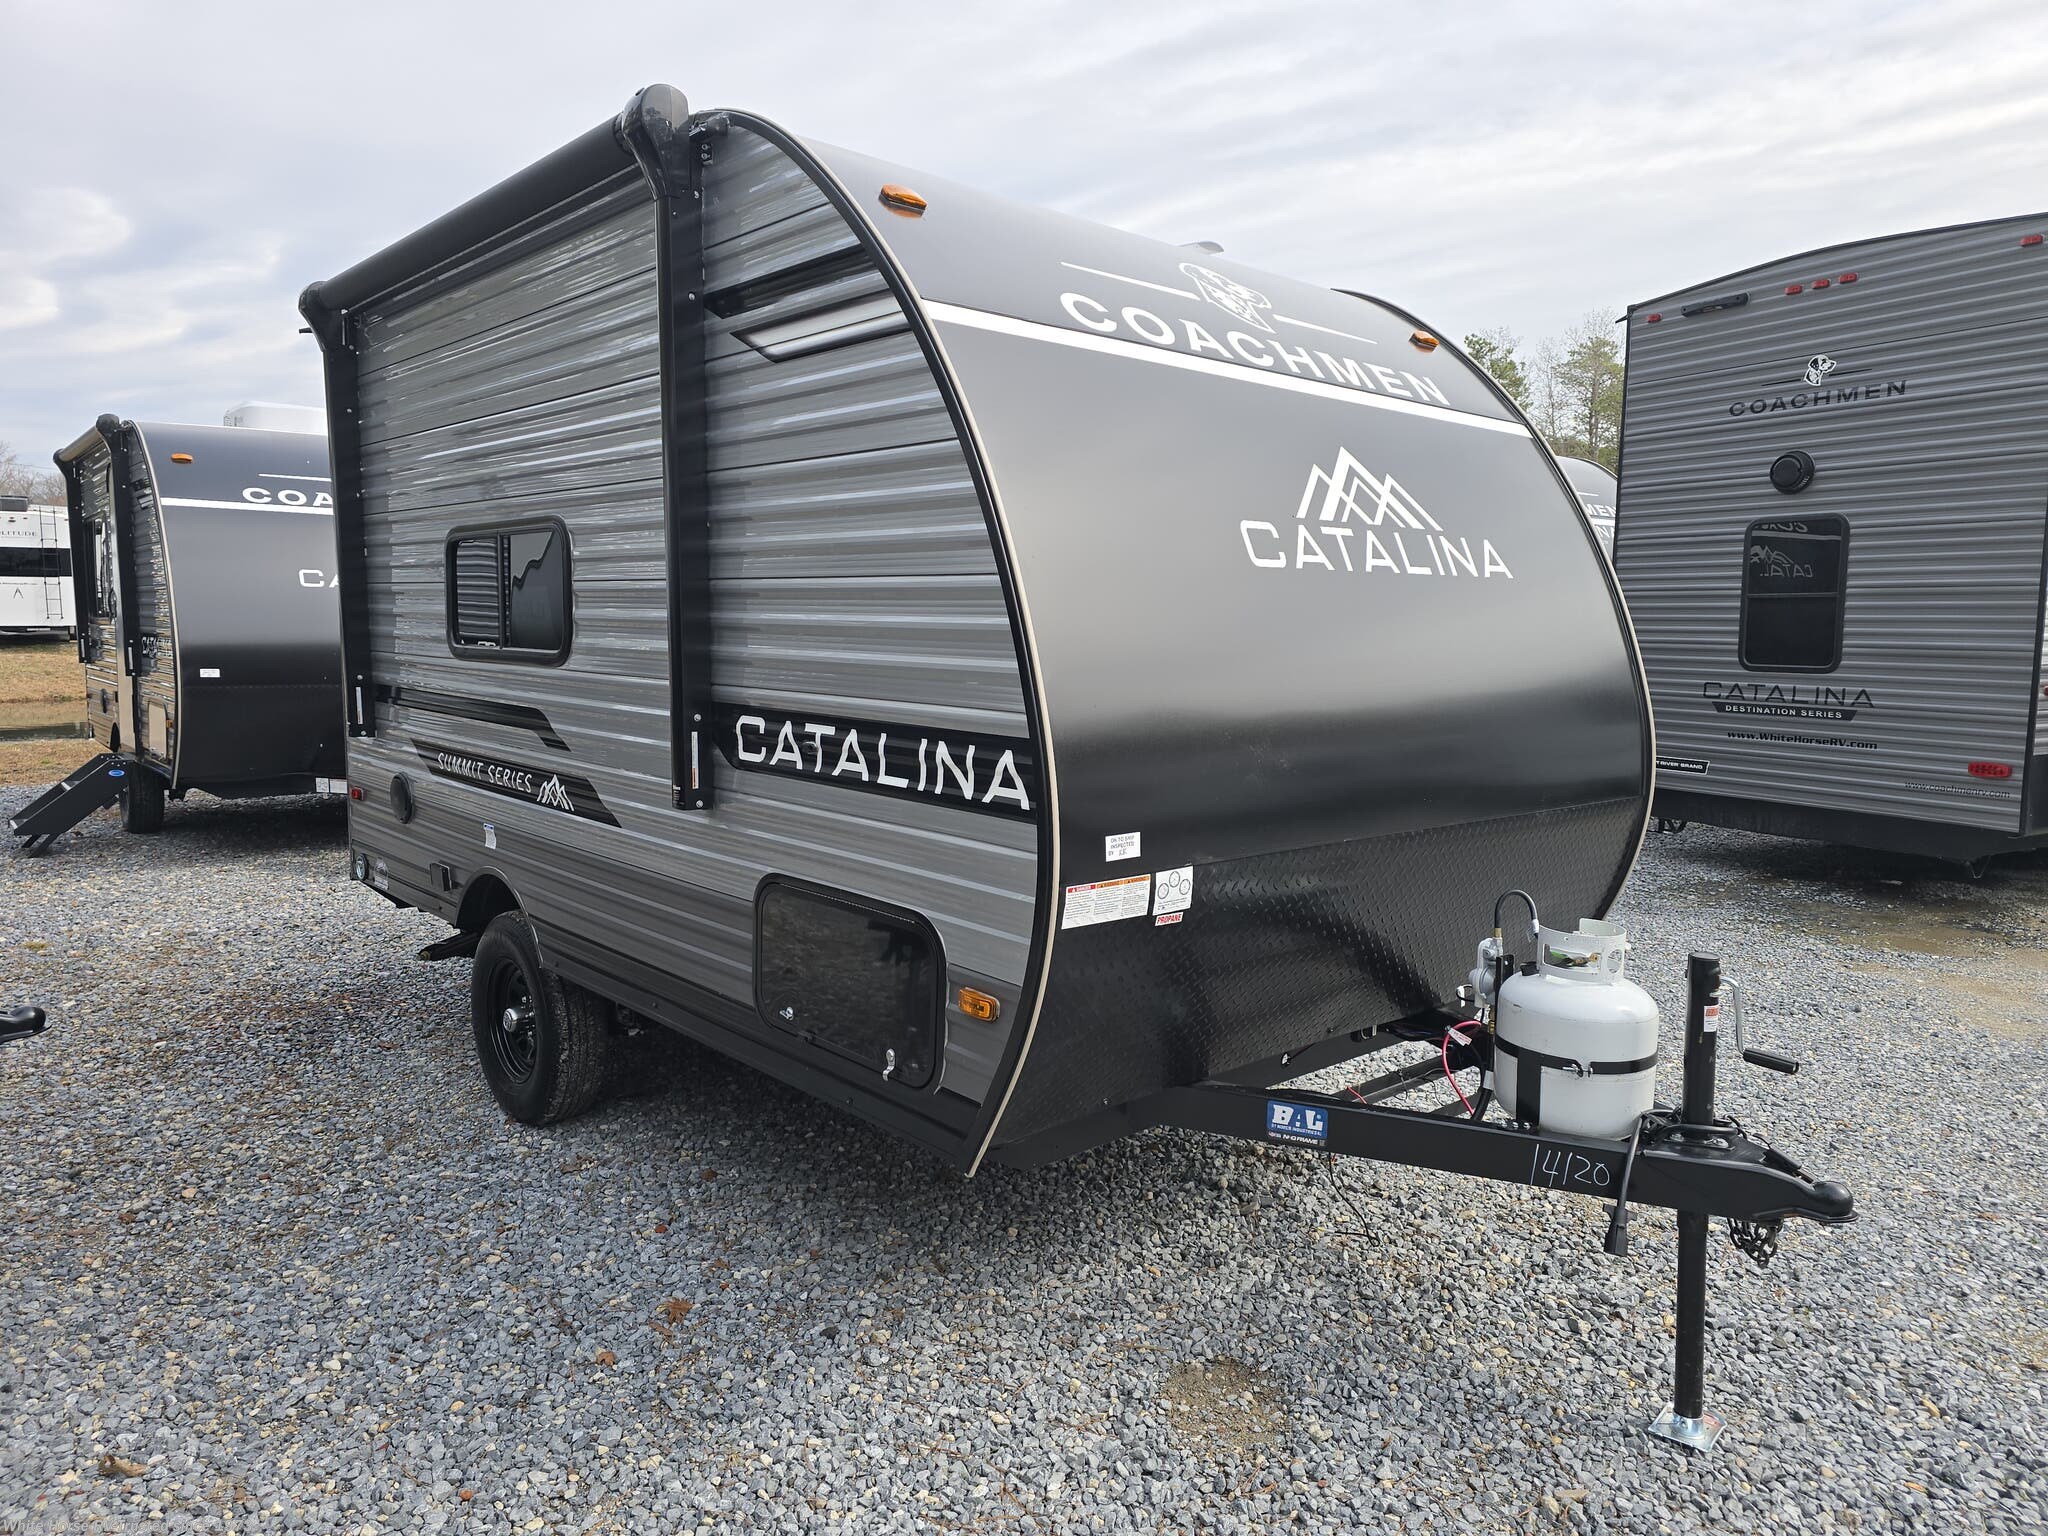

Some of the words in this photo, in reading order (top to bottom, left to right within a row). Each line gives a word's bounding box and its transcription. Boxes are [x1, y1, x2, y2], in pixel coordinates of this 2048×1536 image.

[1060, 292, 1450, 406] COACHMEN
[1729, 380, 1907, 417] COACHMEN
[1240, 519, 1514, 579] CATALINA
[1703, 682, 1875, 708] CATALINA
[1725, 704, 1797, 716] DESTINATION
[1800, 708, 1843, 719] SERIES
[1727, 730, 1878, 750] www.WhiteHorseRV.com
[437, 752, 484, 779] SUMMIT
[487, 764, 533, 793] SERIES
[736, 714, 1030, 811] CATALINA
[1157, 913, 1182, 924] PROPANE
[1530, 1143, 1610, 1188] 14120
